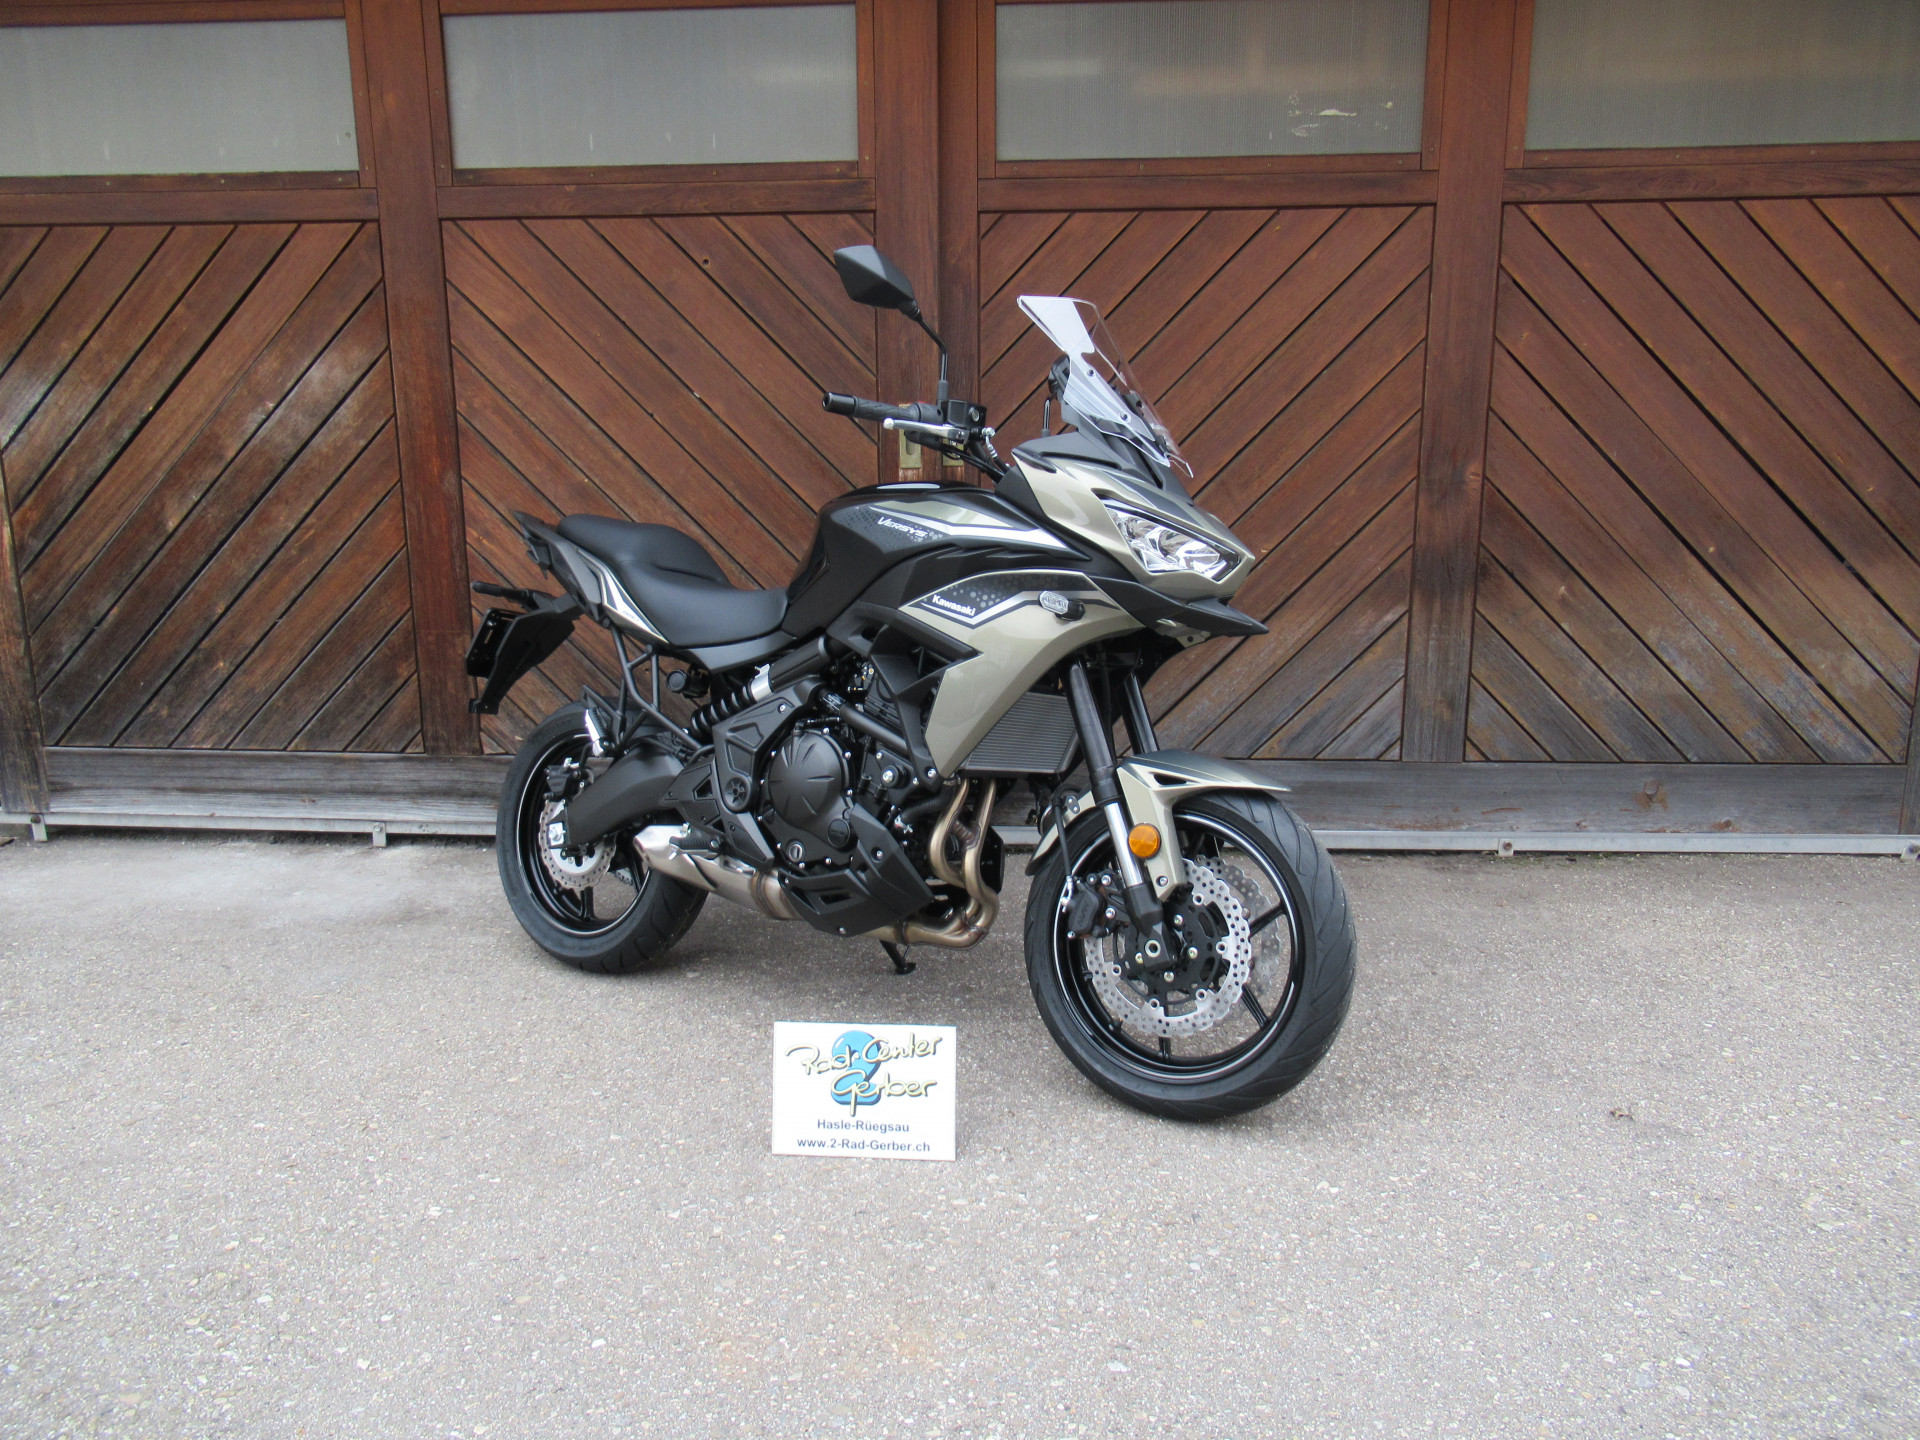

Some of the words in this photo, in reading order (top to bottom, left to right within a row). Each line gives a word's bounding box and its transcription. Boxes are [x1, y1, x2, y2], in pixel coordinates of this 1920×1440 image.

[932, 594, 976, 617] Kawasaki
[831, 1069, 938, 1117] Gerber
[817, 1119, 910, 1134] Hasle-Rüegsau
[797, 1138, 931, 1152] www.2-Rad-Gerber.ch
